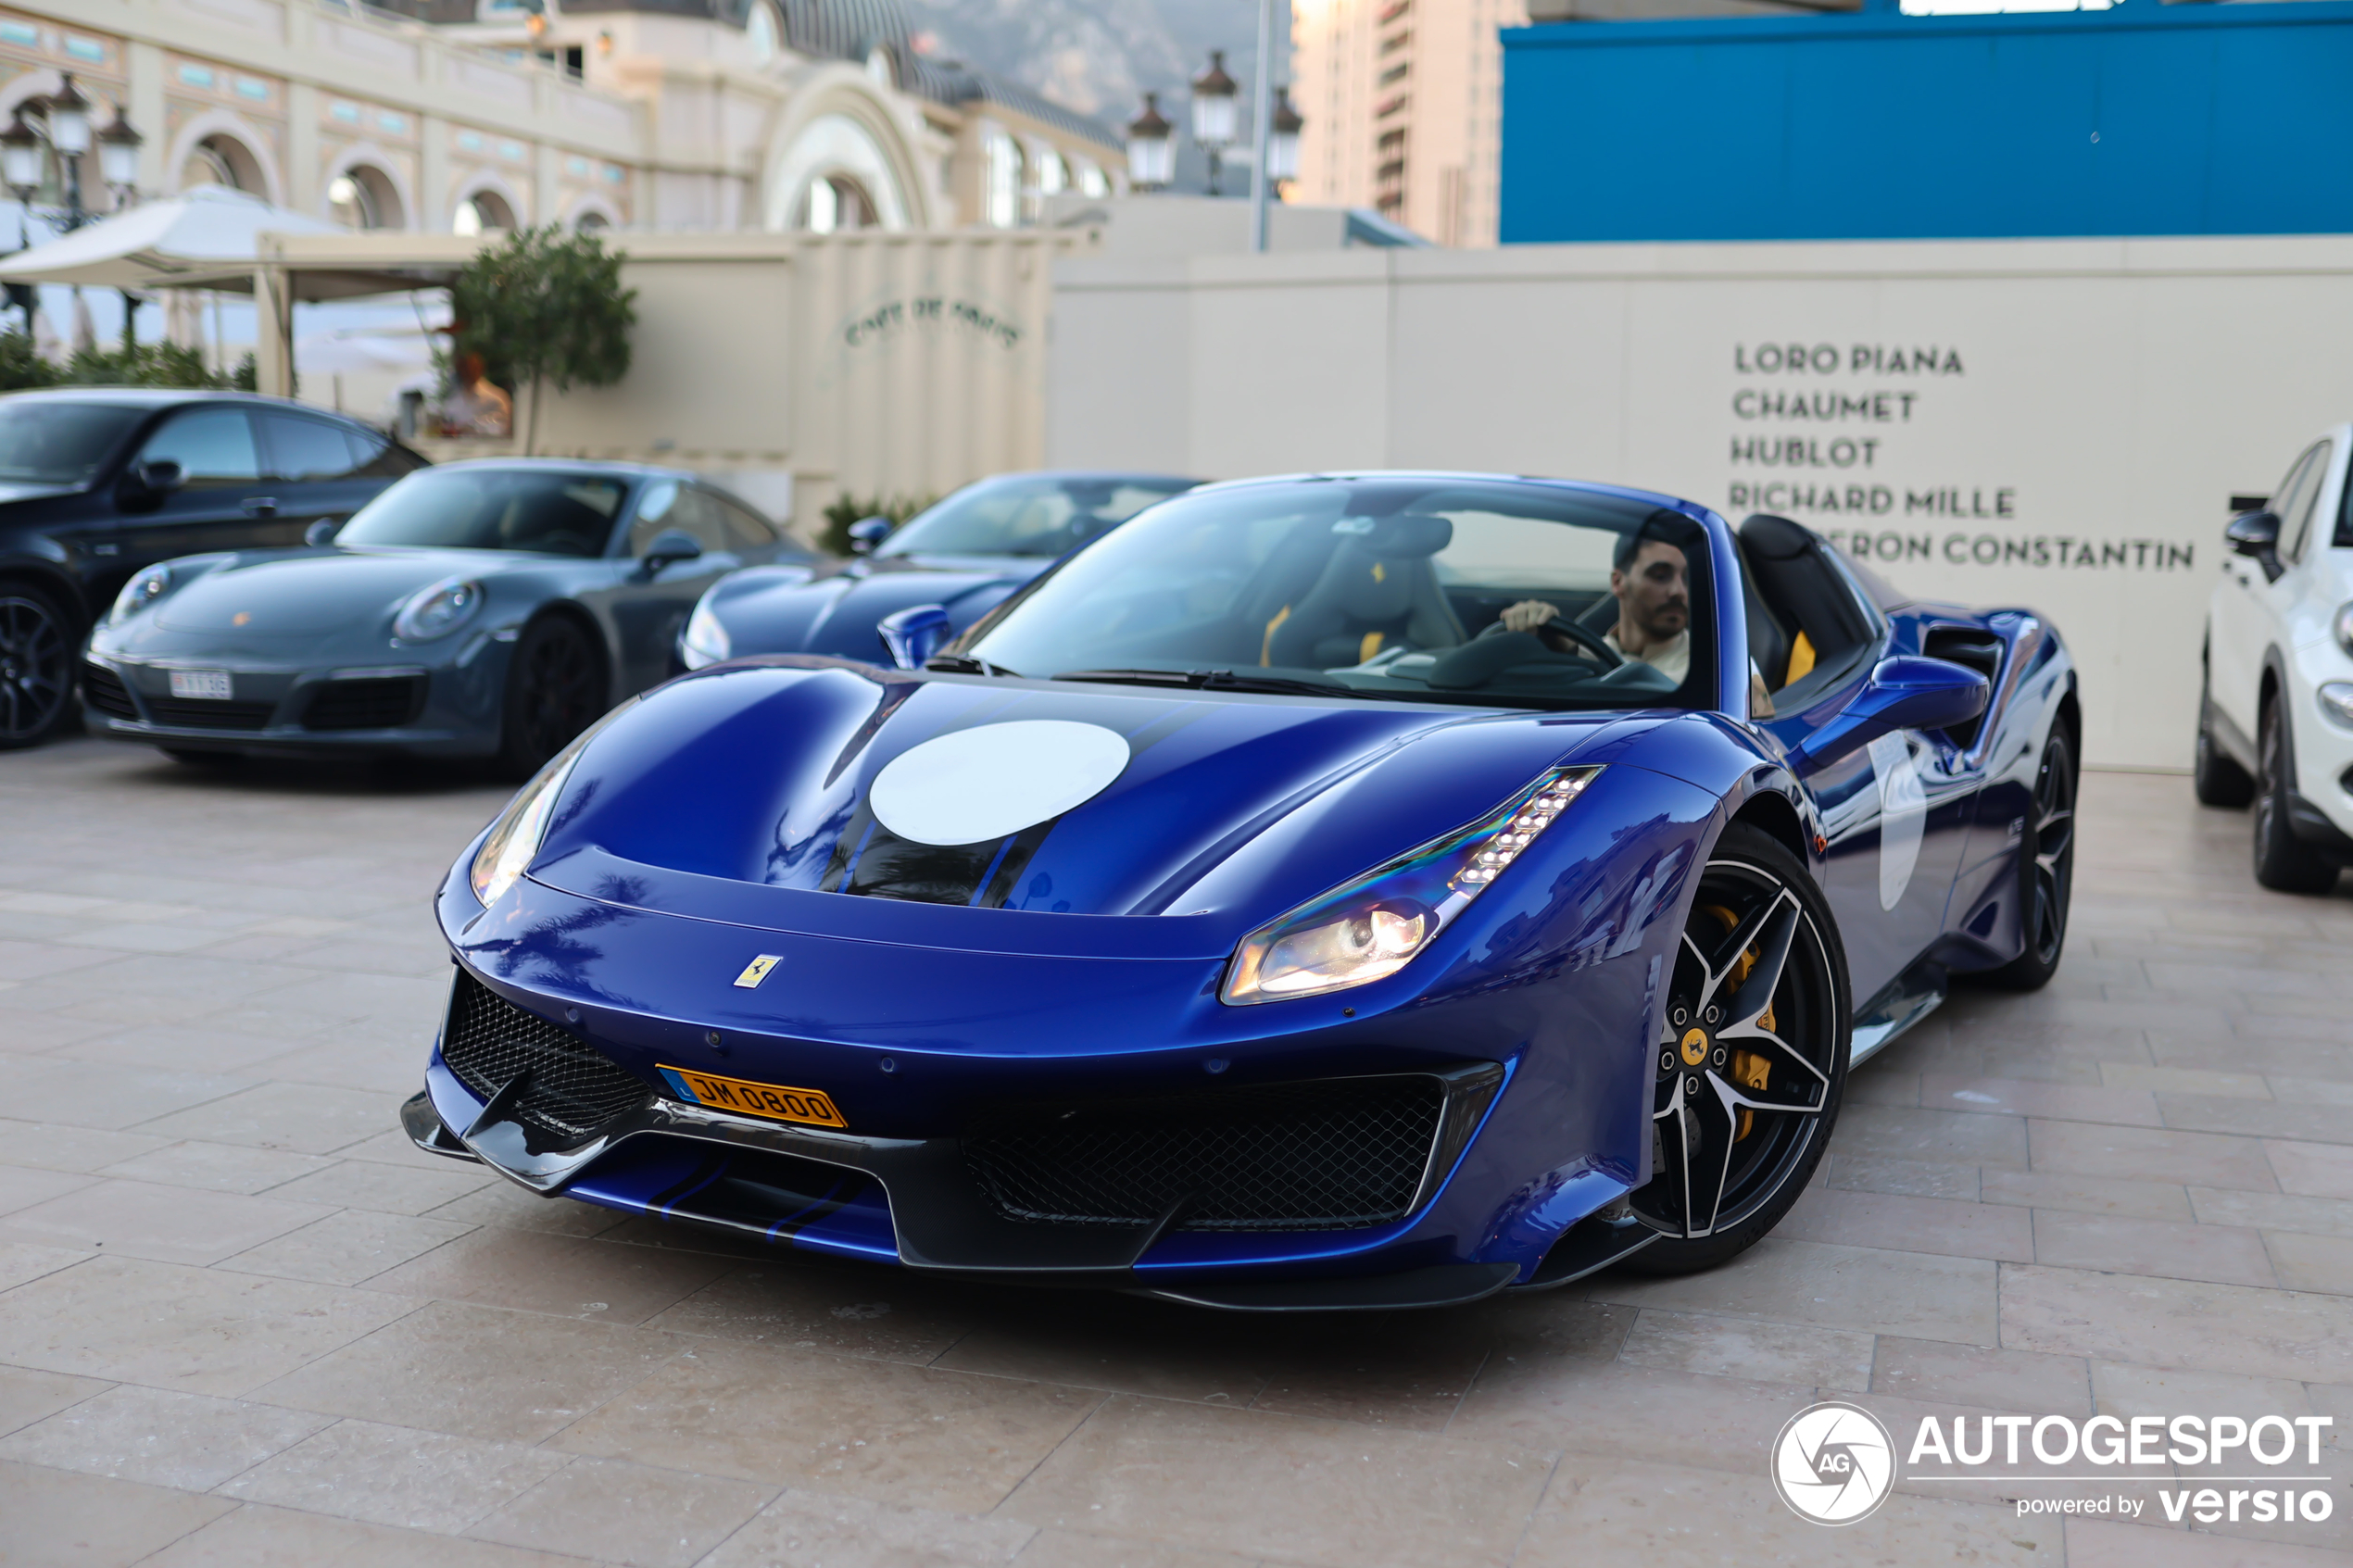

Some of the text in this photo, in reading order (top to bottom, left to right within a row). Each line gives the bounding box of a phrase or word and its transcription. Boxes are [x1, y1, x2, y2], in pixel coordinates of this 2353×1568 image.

[1733, 343, 1965, 376] LORO PIANA
[1731, 389, 1918, 423] CHAUMET
[1730, 436, 1880, 469] HUBLOT
[1728, 482, 2016, 519] RICHARD MILLE
[1941, 533, 2196, 571] CONSTANTIN
[692, 1077, 833, 1121] JM 0800
